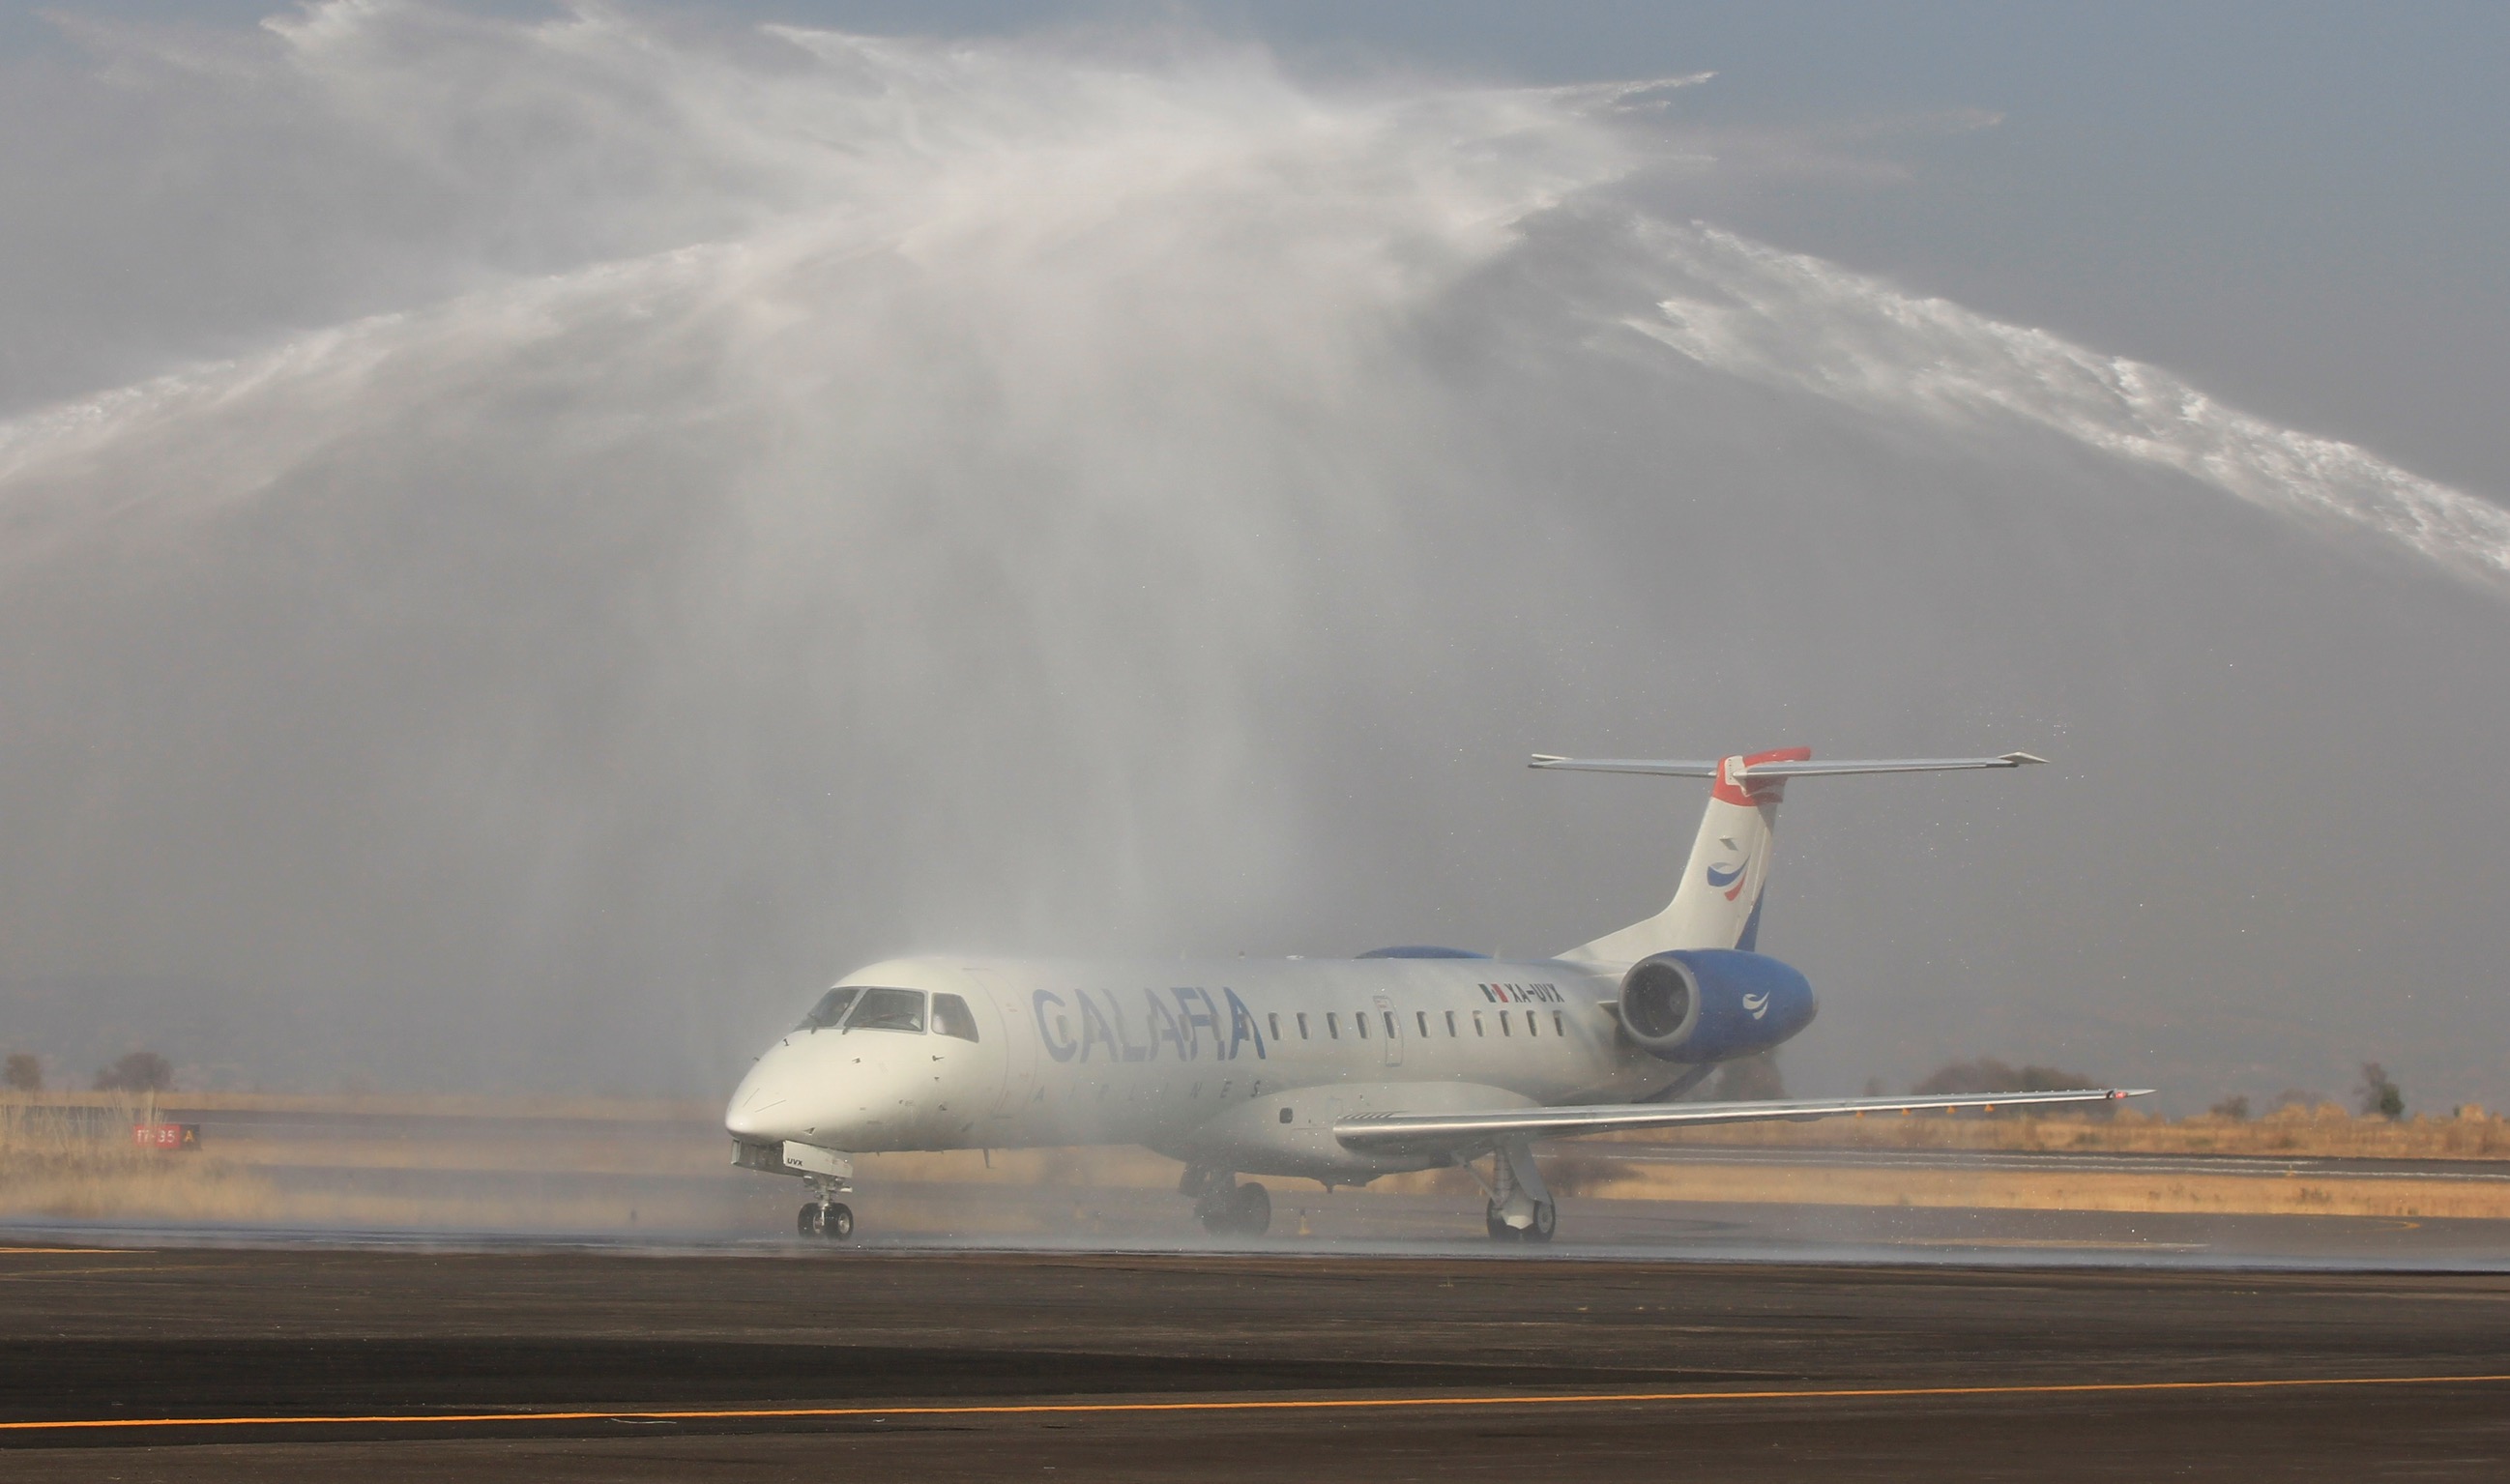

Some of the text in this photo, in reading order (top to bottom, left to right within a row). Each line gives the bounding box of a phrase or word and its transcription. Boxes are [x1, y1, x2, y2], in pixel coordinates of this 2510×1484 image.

[1504, 983, 1564, 1003] XA-UVX
[1032, 987, 1266, 1062] CALAFIA
[185, 1130, 194, 1143] A
[787, 1157, 803, 1166] UVX
